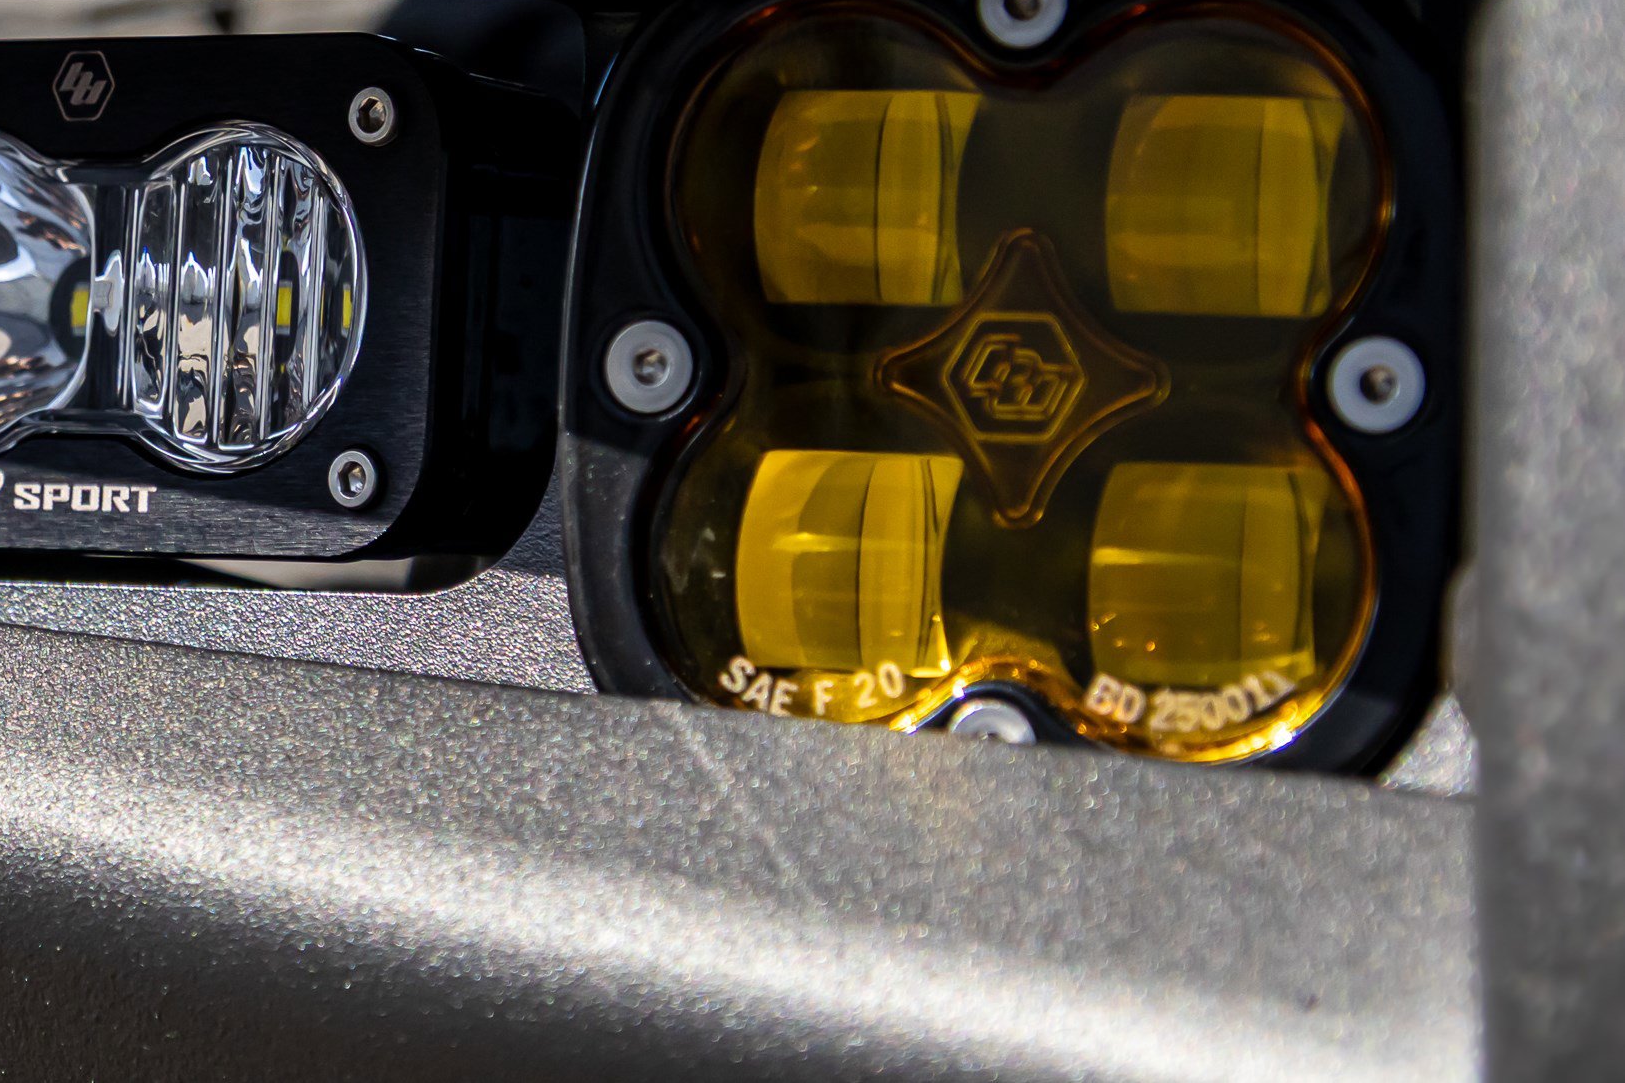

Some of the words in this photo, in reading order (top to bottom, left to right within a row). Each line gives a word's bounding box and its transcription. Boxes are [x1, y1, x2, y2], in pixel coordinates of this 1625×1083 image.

[13, 482, 158, 513] SPORT
[718, 656, 799, 717] SAE
[812, 680, 835, 716] F
[852, 660, 906, 709] 20
[1085, 672, 1146, 724] BD
